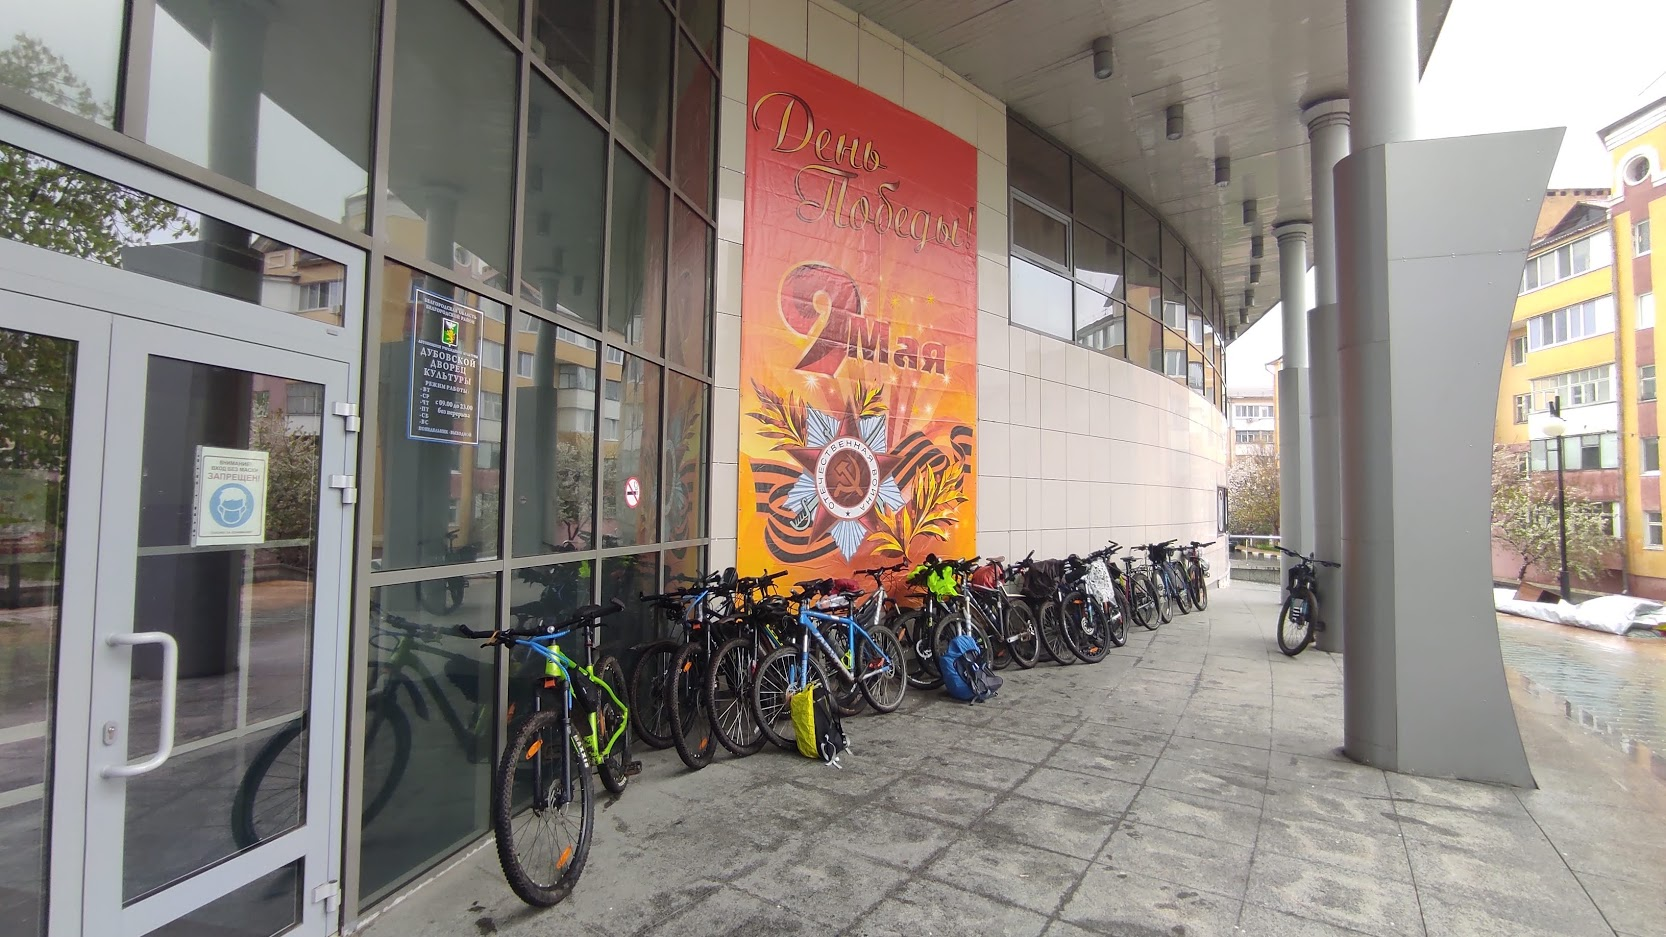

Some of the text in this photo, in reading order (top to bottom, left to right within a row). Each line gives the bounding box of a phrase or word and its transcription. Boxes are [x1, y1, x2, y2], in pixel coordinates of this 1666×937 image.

[752, 92, 887, 172] День
[794, 163, 974, 253] Победы!
[777, 260, 947, 378] 9 Мая
[420, 347, 475, 368] ДУБОВСКОЙ
[431, 359, 466, 375] ДВОРЕЦ
[424, 368, 471, 385] КУЛЬТУРЫ
[425, 381, 445, 389] РЕЖИМ
[438, 399, 453, 407] 09.00
[207, 473, 261, 482] ЗАПРЕЩЕН!
[818, 440, 874, 509] ОТЕЧЕСТВЕННАЯ
